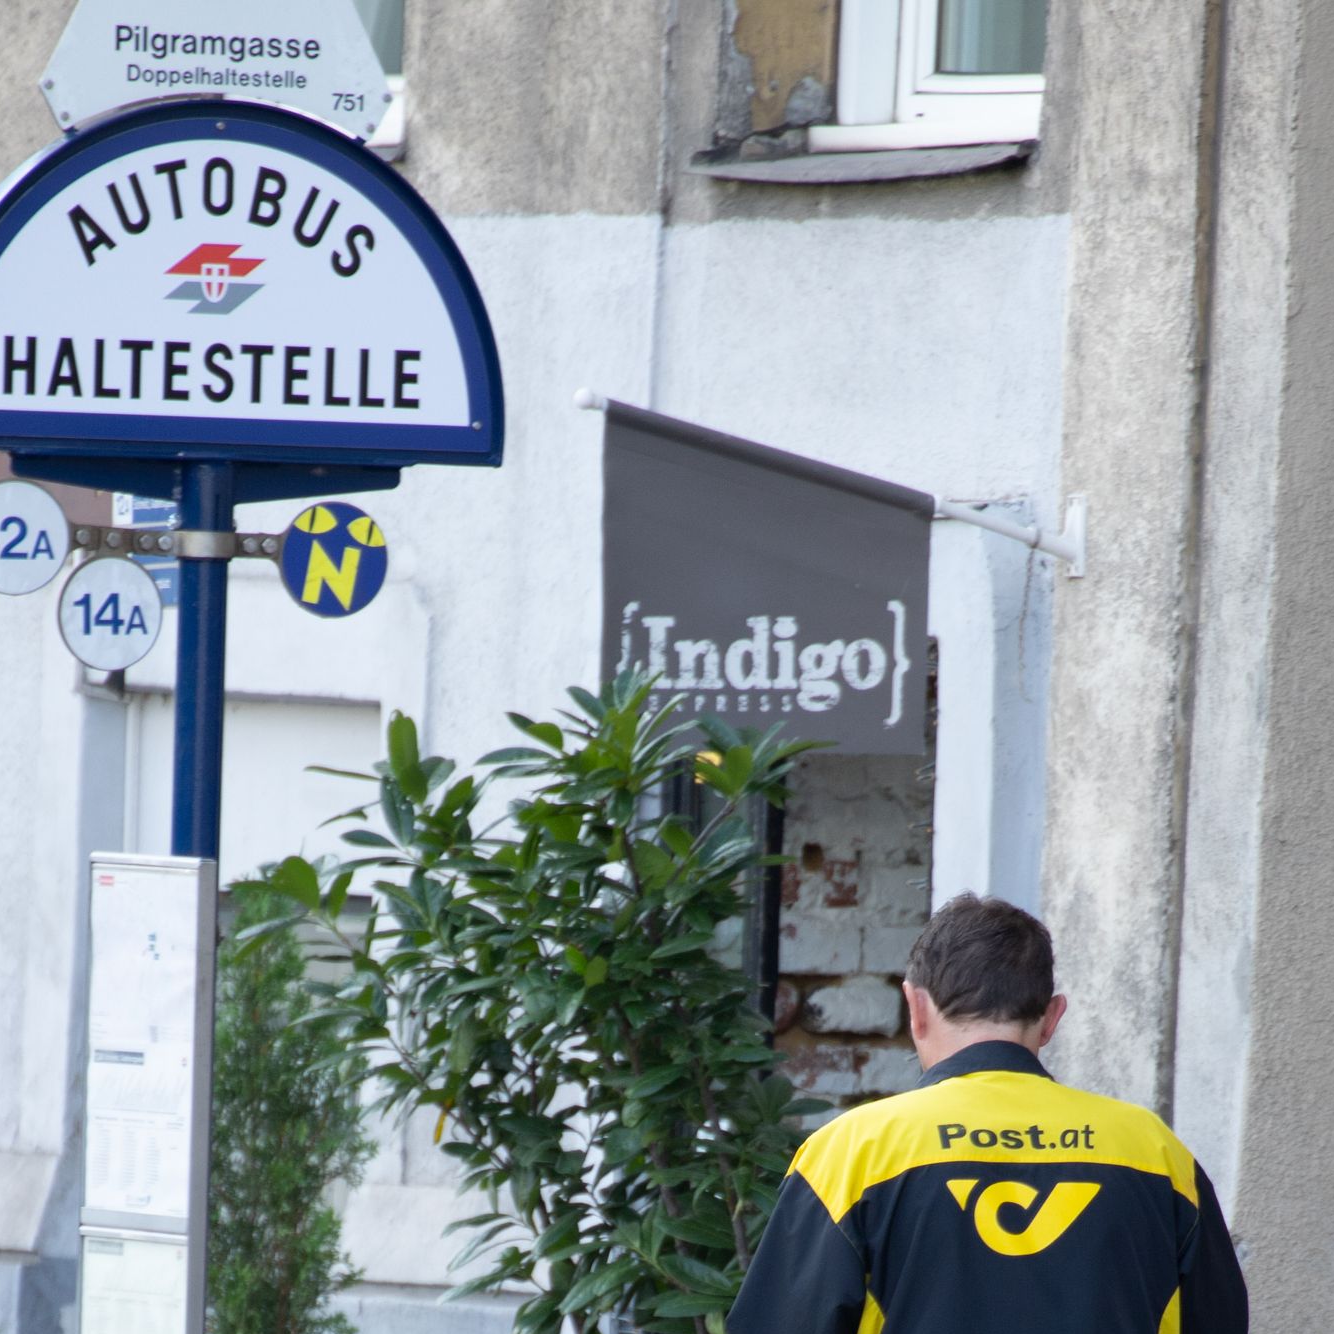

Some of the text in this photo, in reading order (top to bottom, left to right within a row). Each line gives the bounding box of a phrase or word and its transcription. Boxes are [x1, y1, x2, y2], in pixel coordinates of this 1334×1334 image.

[115, 24, 322, 63] Pilgramgasse
[126, 63, 308, 89] Doppelhaltestelle
[331, 92, 366, 113] 751
[66, 156, 376, 278] AUTOBUS
[2, 334, 422, 410] HALTESTELLE
[300, 539, 361, 611] N
[72, 592, 149, 636] 14A
[936, 1123, 1096, 1151] Post.at
